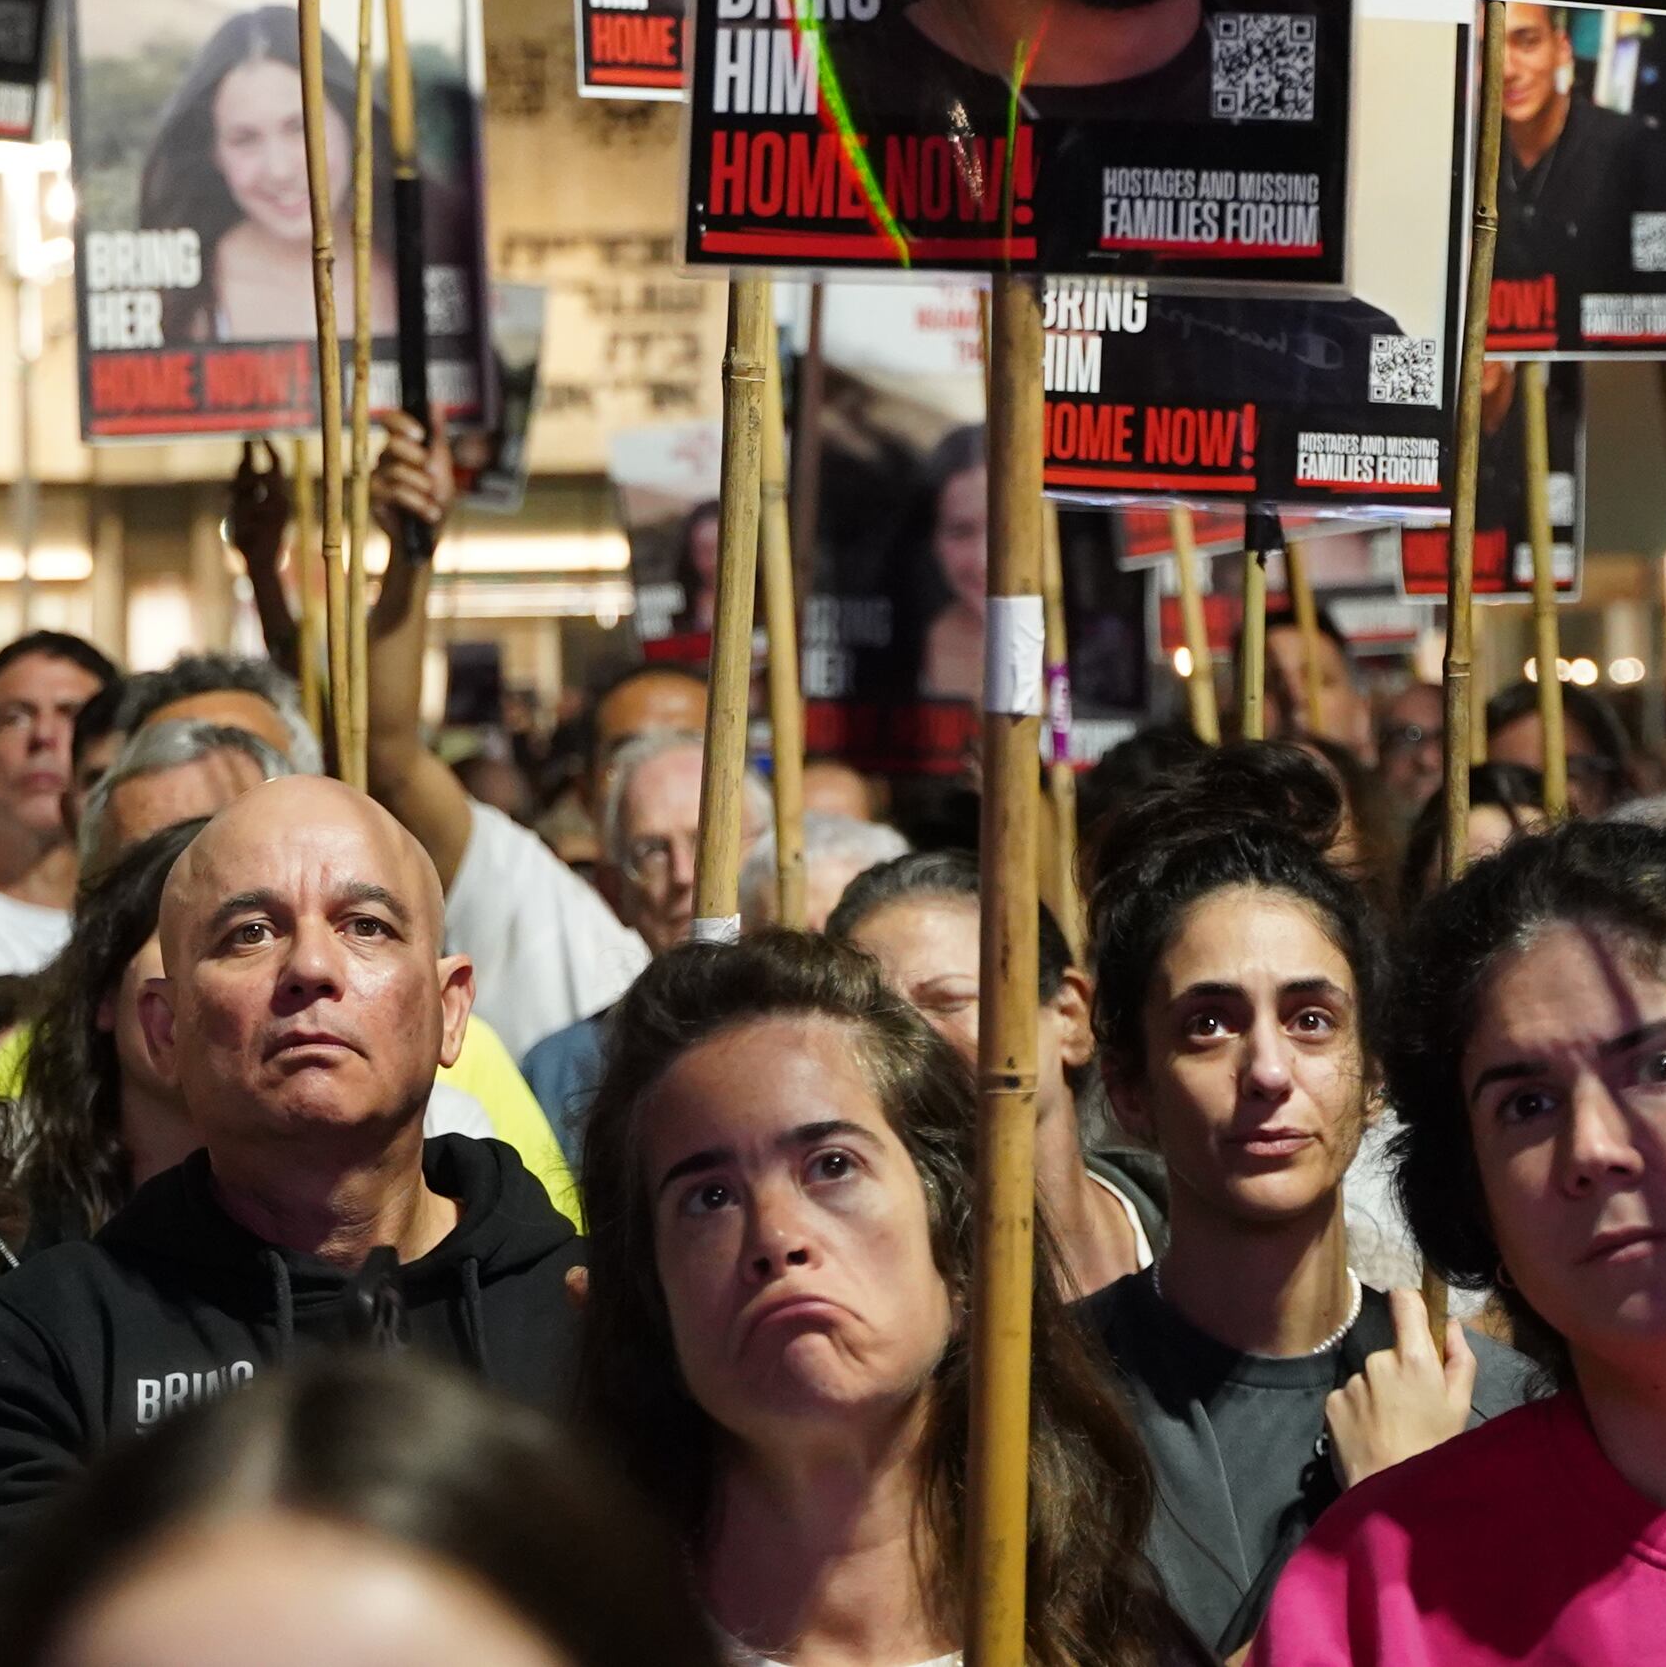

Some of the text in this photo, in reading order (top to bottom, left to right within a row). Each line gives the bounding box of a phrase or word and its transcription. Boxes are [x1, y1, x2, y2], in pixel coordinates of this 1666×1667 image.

[591, 12, 677, 66] HOME
[712, 28, 820, 115] HIM
[708, 125, 1035, 226] HOME NOW!
[1102, 167, 1320, 205] HOSTAGES AND MISSING
[1102, 197, 1320, 247] FAMILIES FORUM
[86, 228, 202, 290] BRING
[88, 290, 164, 350] HER
[1044, 402, 1257, 470] OME NOW!
[1299, 432, 1440, 458] HOSTAGES AND MISSING
[1298, 452, 1439, 486] FAMILIES FORUM
